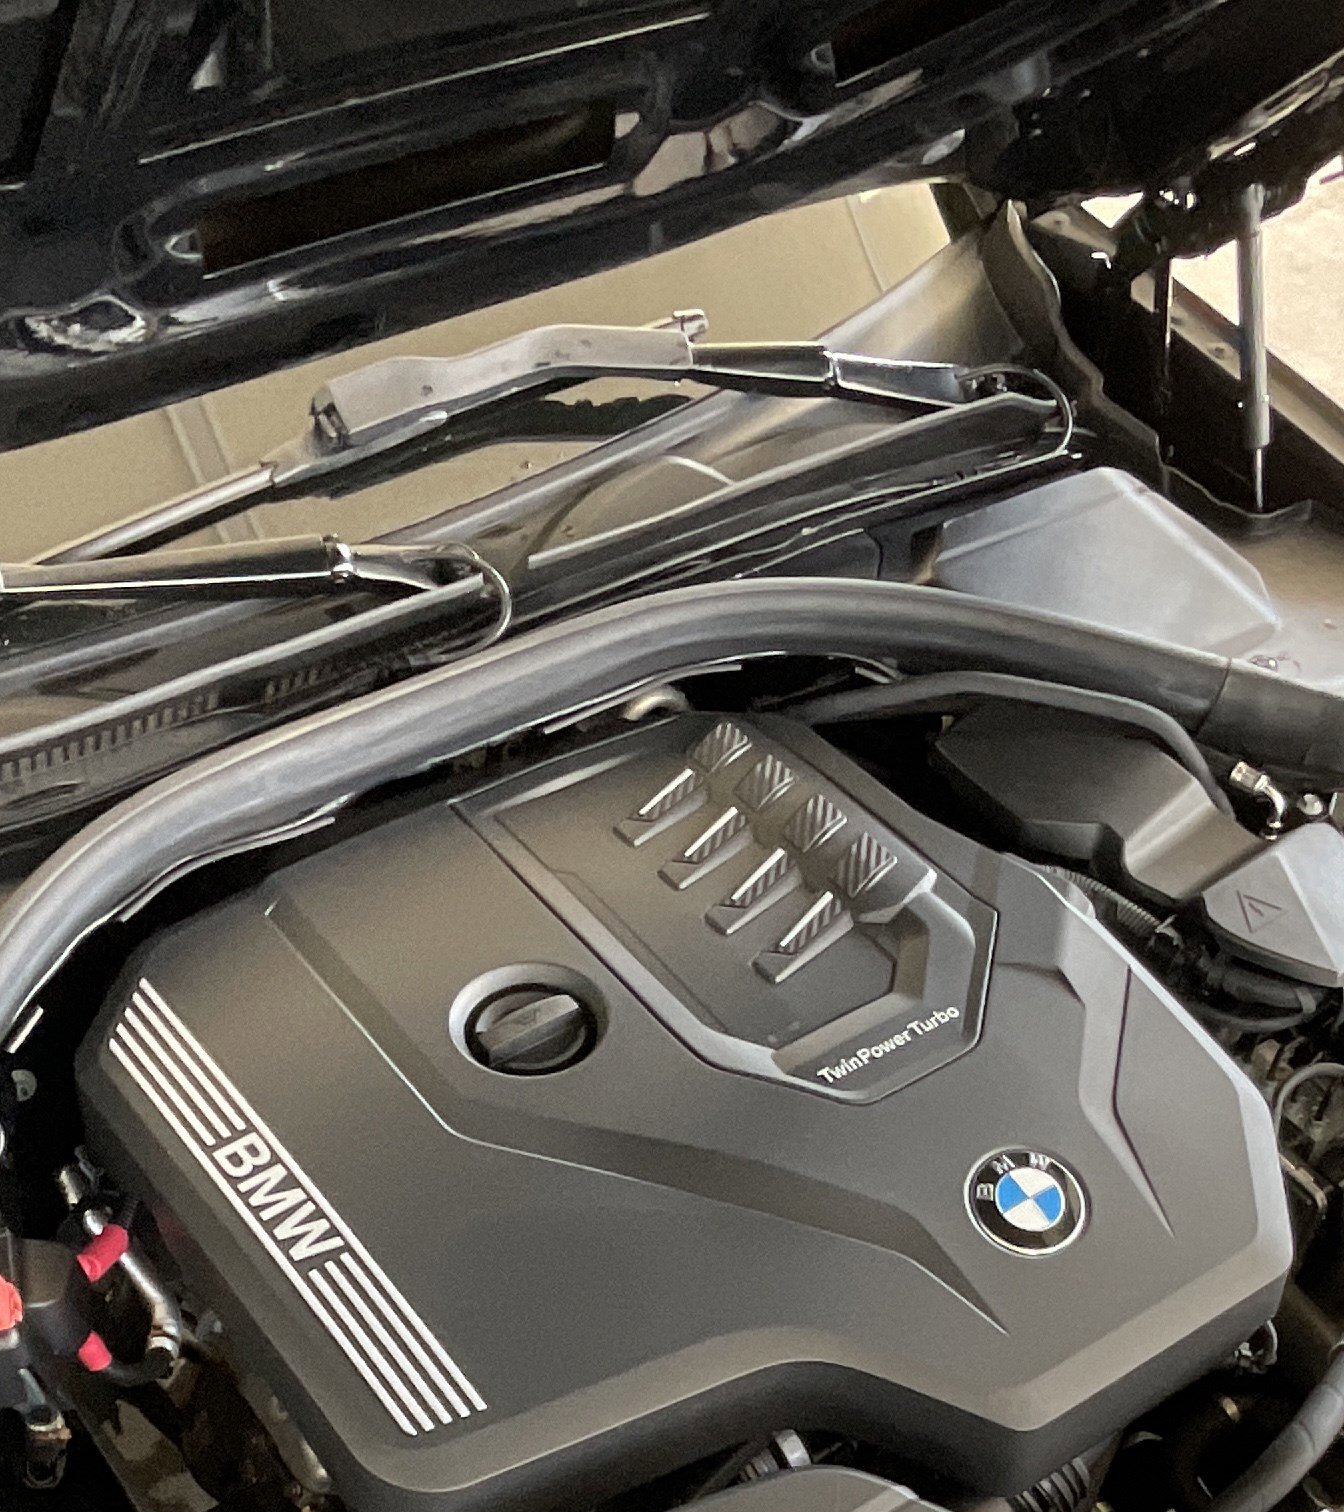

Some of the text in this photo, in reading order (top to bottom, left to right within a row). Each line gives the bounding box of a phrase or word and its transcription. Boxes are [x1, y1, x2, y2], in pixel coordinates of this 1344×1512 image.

[907, 1006, 960, 1035] Turbo
[212, 1131, 345, 1262] BMW
[976, 1151, 1051, 1201] BMW
